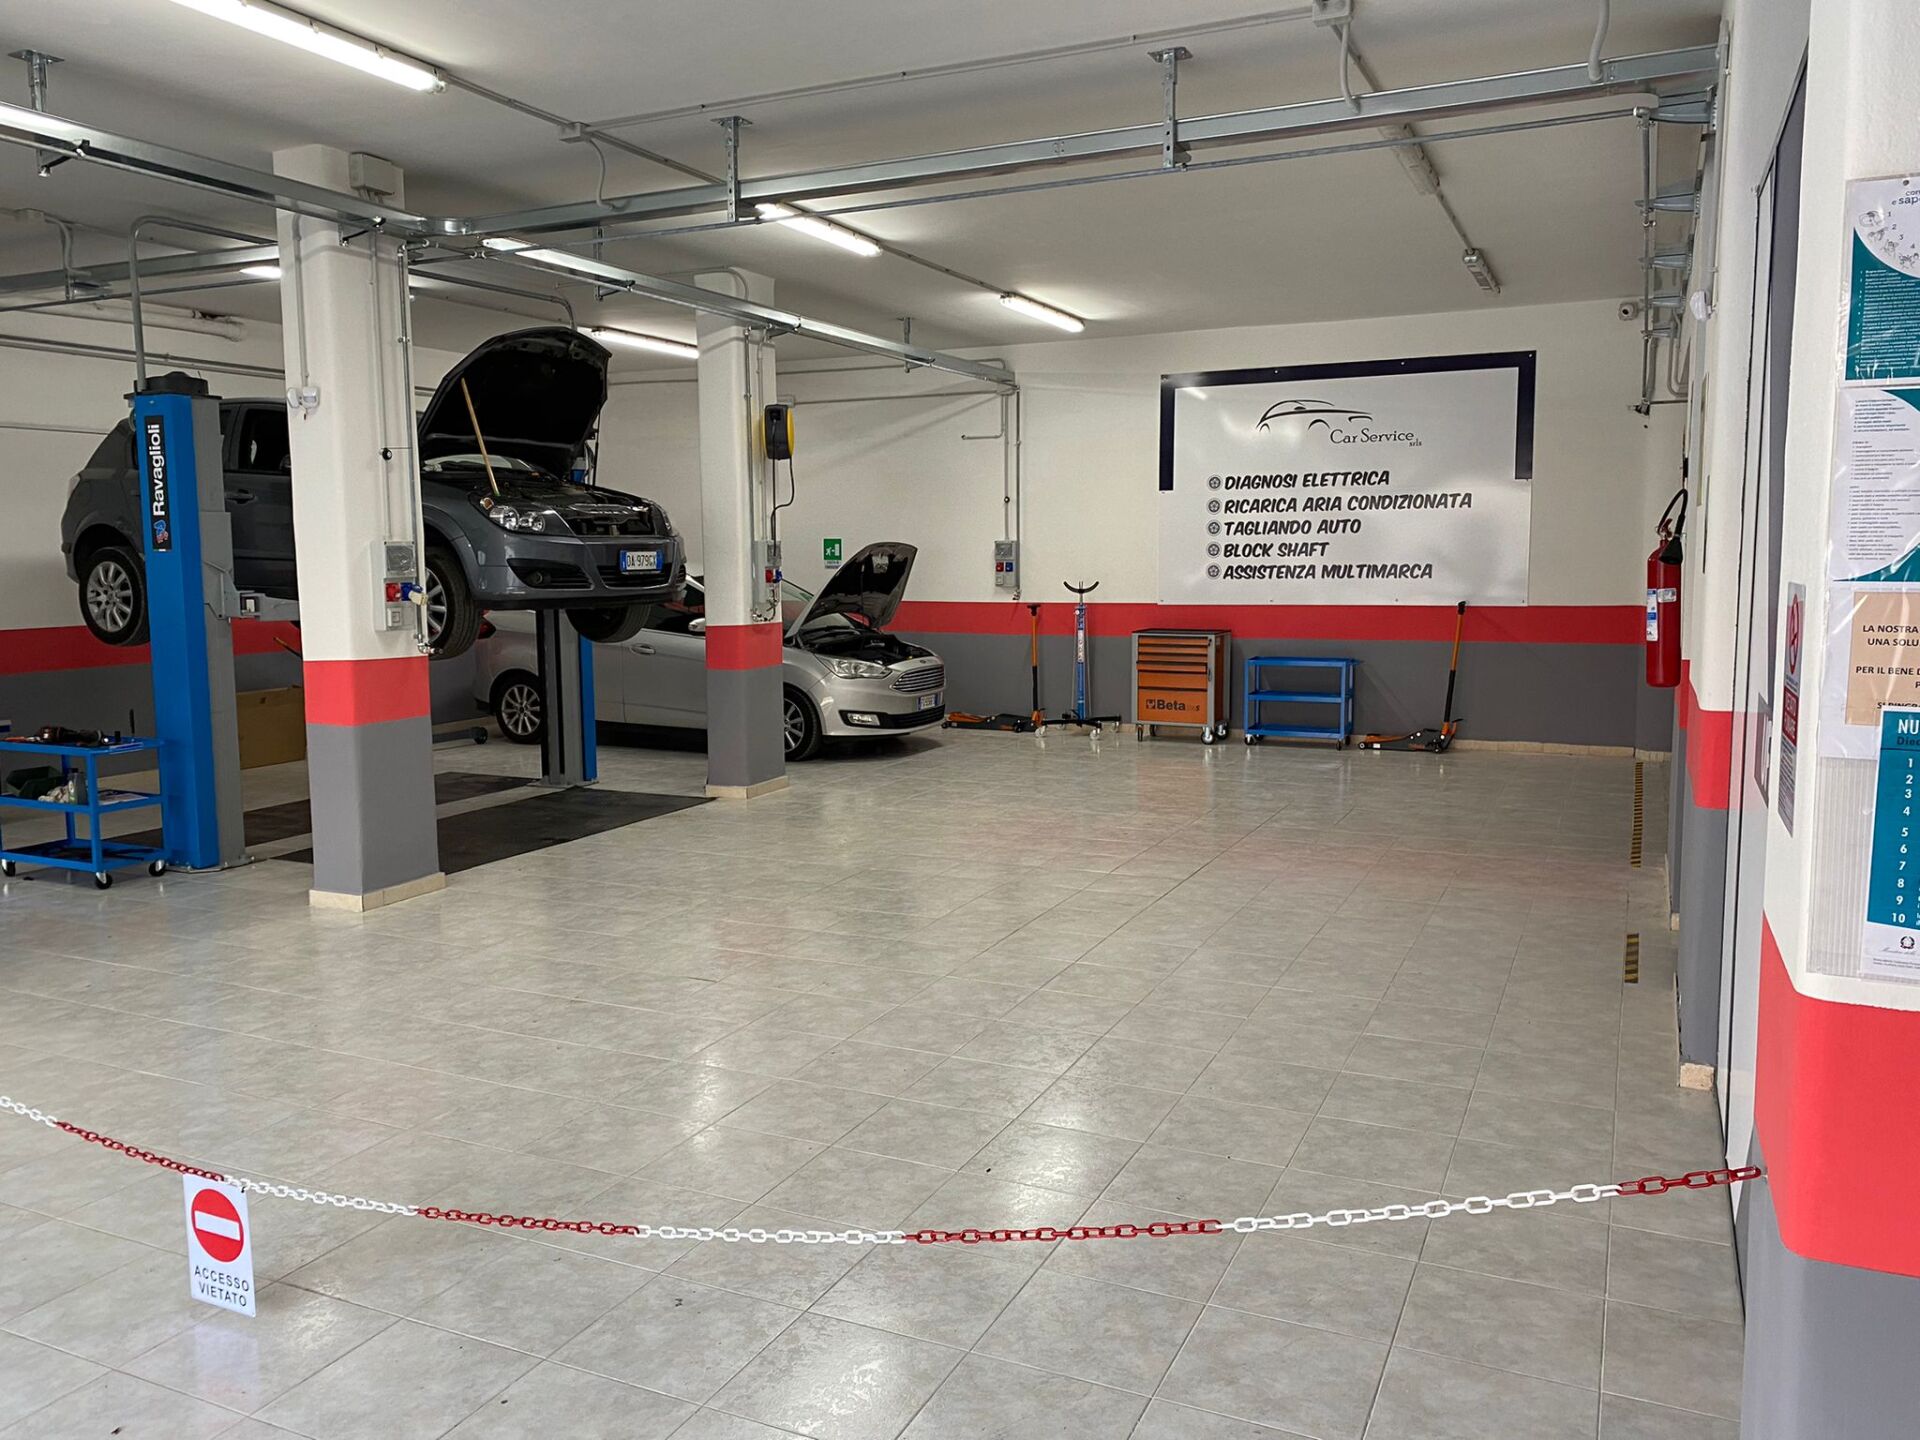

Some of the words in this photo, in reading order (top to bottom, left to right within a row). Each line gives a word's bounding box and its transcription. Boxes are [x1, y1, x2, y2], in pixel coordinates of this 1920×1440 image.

[1330, 429, 1358, 444] Car
[1360, 427, 1414, 442] Service
[148, 424, 166, 516] Ravaglioli
[1224, 473, 1297, 491] DIAGNOSI
[1302, 470, 1390, 488] ELETTRICA
[1224, 497, 1297, 514] RICARICA
[1302, 495, 1342, 512] ARIA
[1347, 493, 1472, 512] CONDIZIONATA
[1224, 519, 1312, 536] TAGLIANDO
[1317, 518, 1361, 535] AUTO
[1223, 542, 1274, 558] BLOCK
[1277, 541, 1330, 557] SHAFT
[1223, 564, 1316, 580] ASSISTENZA
[1321, 563, 1433, 580] MULTIMARCA
[1862, 624, 1875, 633] LA
[1877, 624, 1919, 634] NOSTRA
[1867, 638, 1890, 646] UNA
[1892, 638, 1920, 647] SOLU
[1855, 665, 1874, 674] PER
[1877, 666, 1885, 674] IL
[1888, 667, 1914, 676] BENE
[1157, 699, 1186, 711] Beta
[1908, 758, 1913, 768] 1
[1905, 774, 1913, 785] 2
[1904, 788, 1912, 799] 3
[1903, 806, 1911, 816] 4
[1901, 827, 1909, 837] 5
[1900, 844, 1908, 854] 6
[1899, 861, 1906, 871] 7
[1897, 878, 1905, 888] 8
[1896, 895, 1904, 905] 9
[1891, 912, 1906, 924] 10
[194, 1265, 250, 1292] ACCESSO
[198, 1281, 247, 1307] VIETATO
